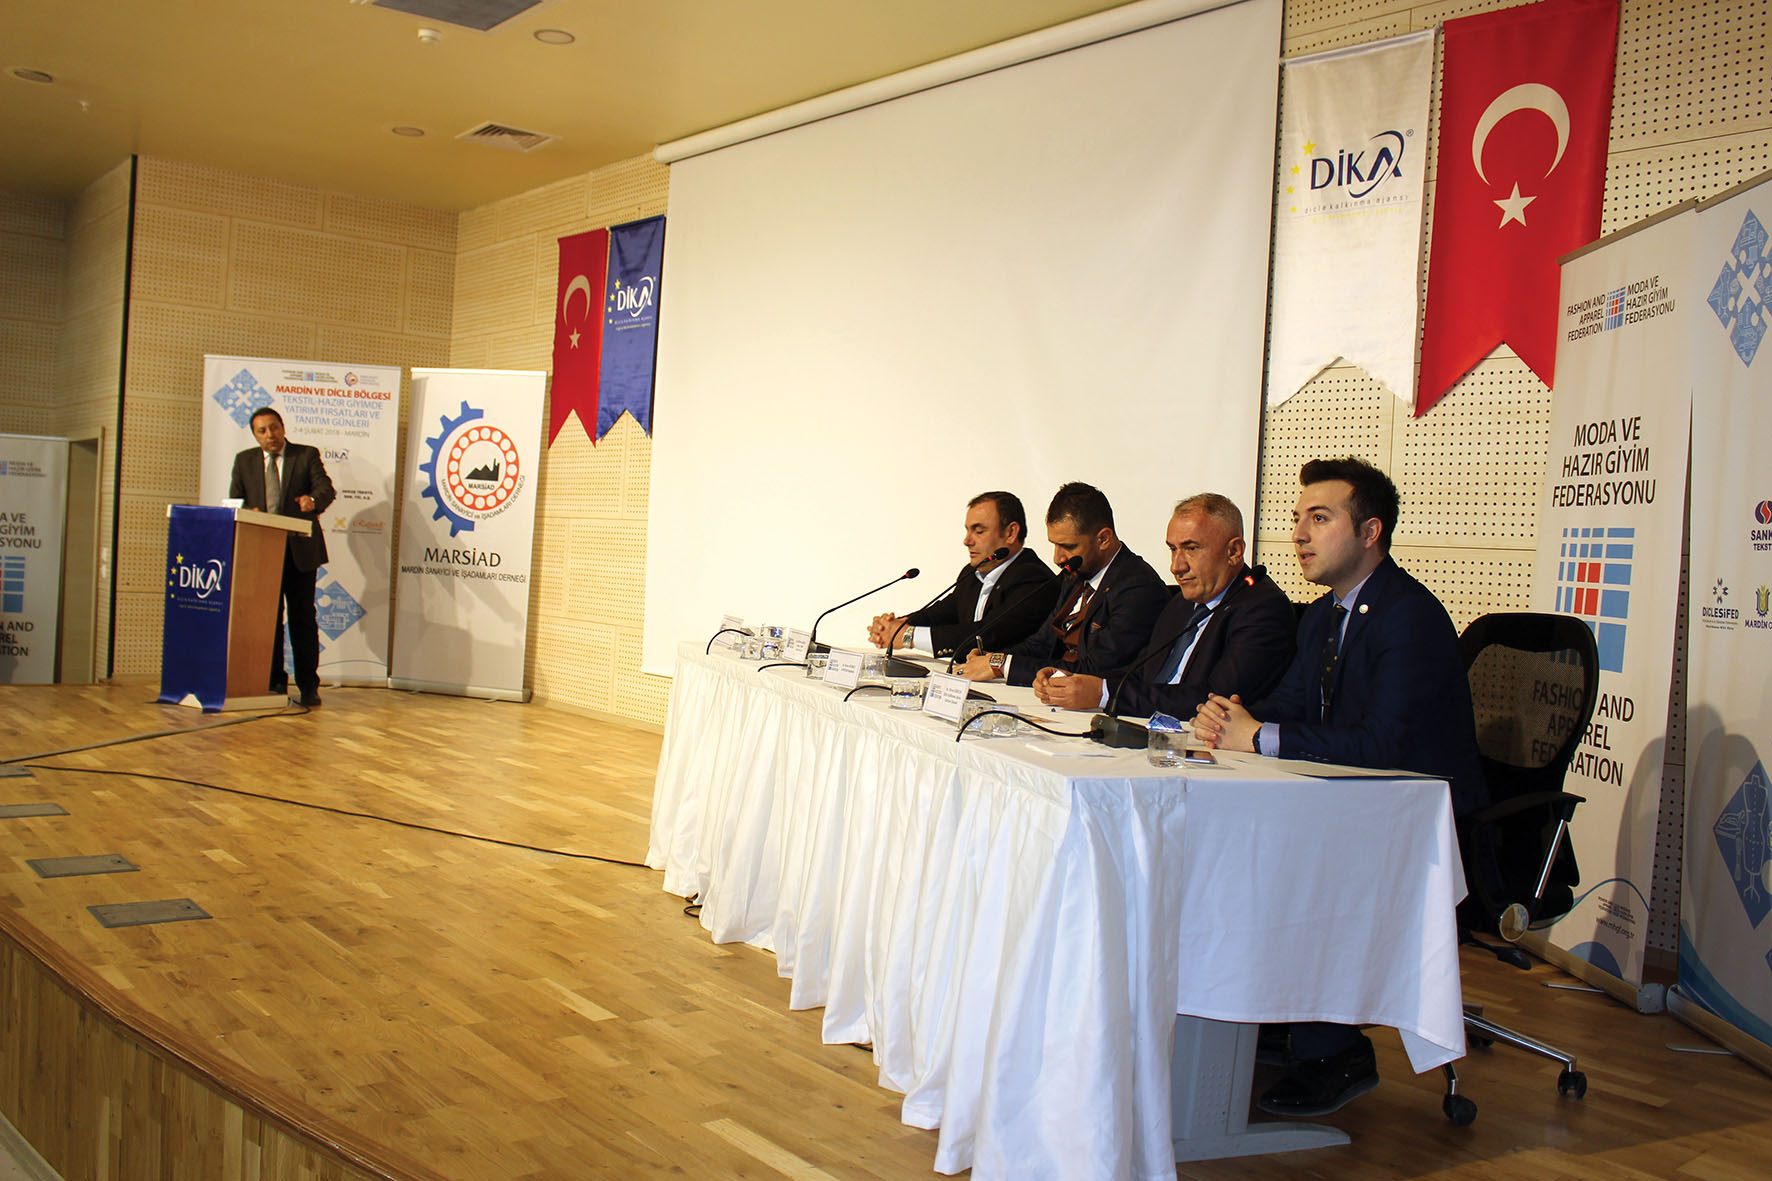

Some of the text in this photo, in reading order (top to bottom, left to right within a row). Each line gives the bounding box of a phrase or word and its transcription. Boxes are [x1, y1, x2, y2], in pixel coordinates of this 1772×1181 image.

[1311, 140, 1403, 194] DİKA
[1627, 275, 1659, 296] MODA VE
[617, 281, 653, 314] DİKA
[1567, 294, 1606, 316] FASHION AND
[1626, 286, 1668, 311] HAZIR GİYİM
[1579, 308, 1604, 326] APPAREL
[1624, 299, 1676, 325] FEDERASYONU
[1567, 321, 1604, 342] FEDERATION
[275, 385, 392, 400] MARDİN VE DİCLE BÖLGESİ
[284, 405, 381, 419] YATIRIM FIRSATLARI VE
[295, 415, 330, 425] TANITIM
[1574, 416, 1642, 447] MODA VE
[1562, 443, 1650, 478] HAZIR GİYİM
[1552, 478, 1657, 508] FEDERASYONU
[10, 512, 26, 523] VE
[424, 547, 501, 567] MARSİAD
[180, 561, 222, 594] DİKA
[451, 569, 460, 577] VE
[7, 621, 34, 632] AND
[1598, 693, 1635, 722] AND
